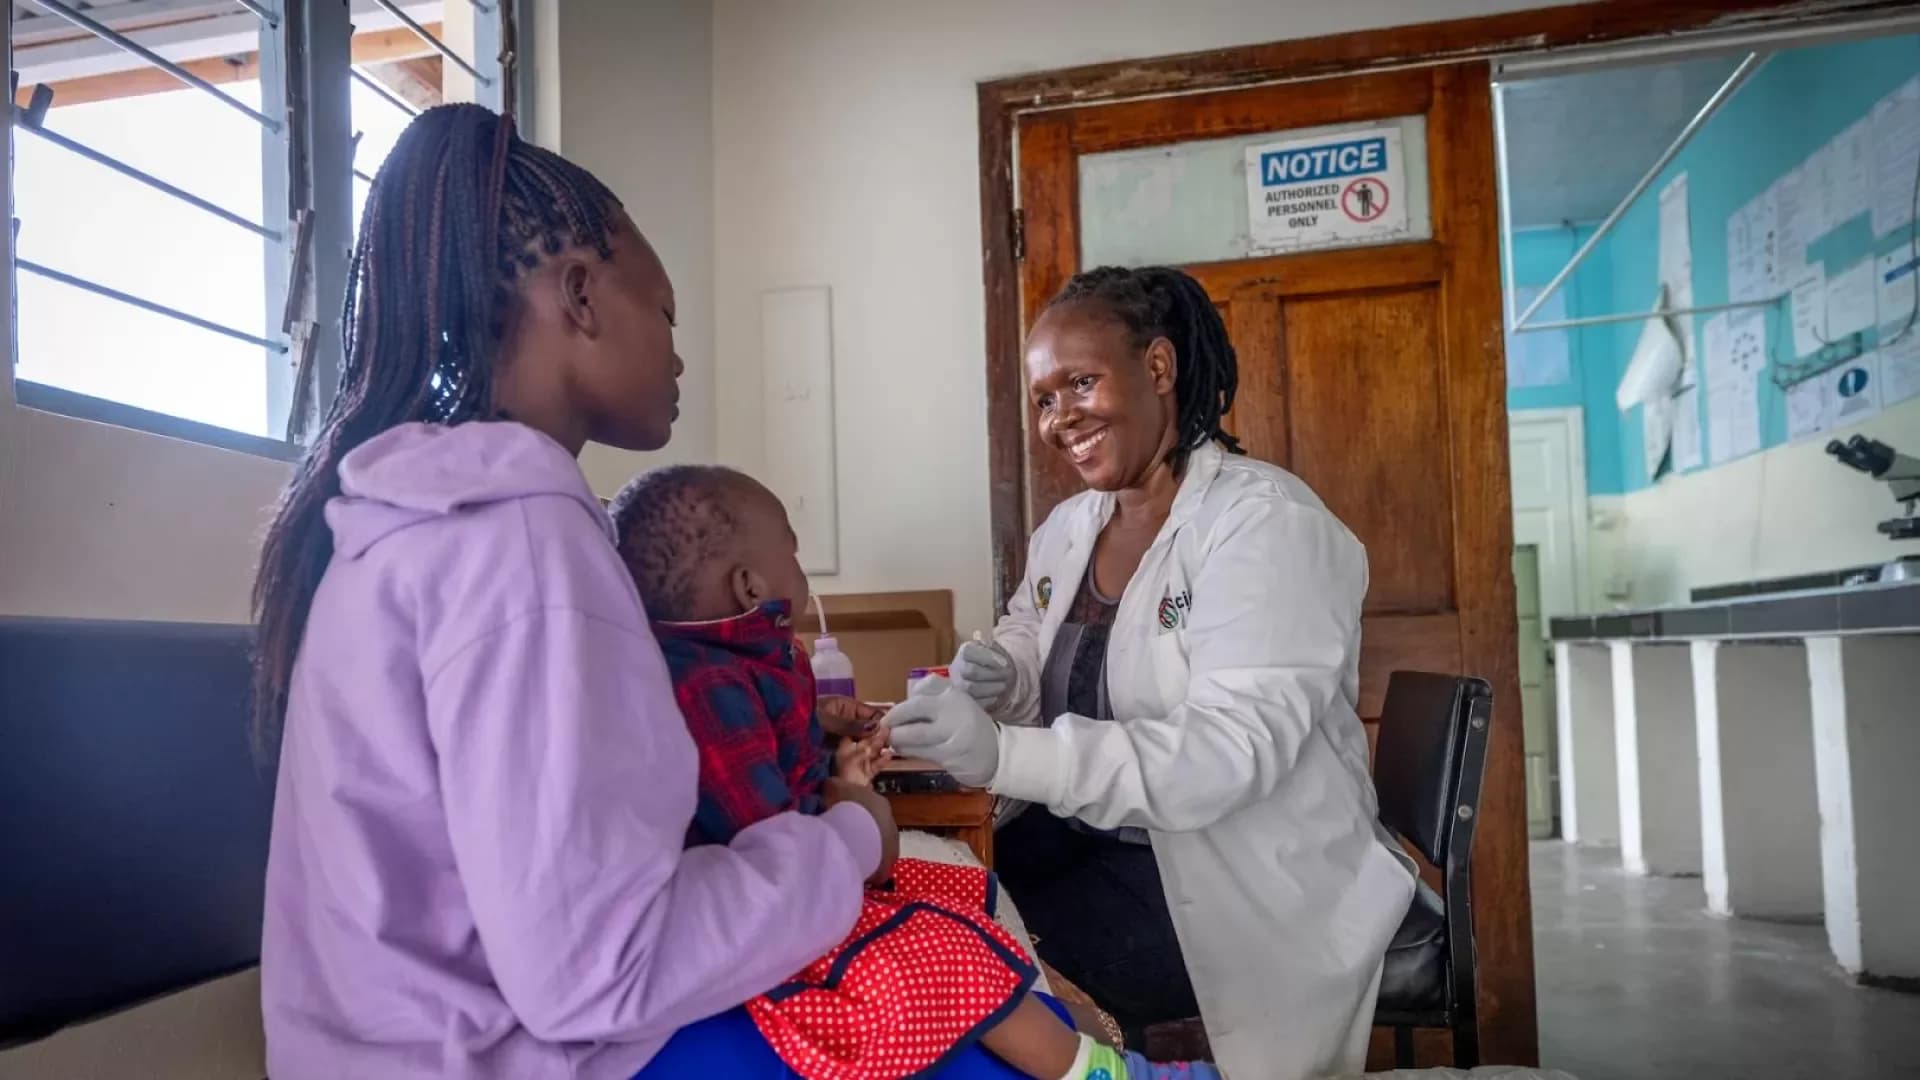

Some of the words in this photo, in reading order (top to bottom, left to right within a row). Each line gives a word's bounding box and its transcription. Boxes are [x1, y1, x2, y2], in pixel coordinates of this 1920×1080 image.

[1267, 142, 1381, 182] NOTICE
[1265, 183, 1340, 203] AUTHORIZED
[1267, 199, 1338, 217] PERSONNEL
[1288, 215, 1318, 229] ONLY
